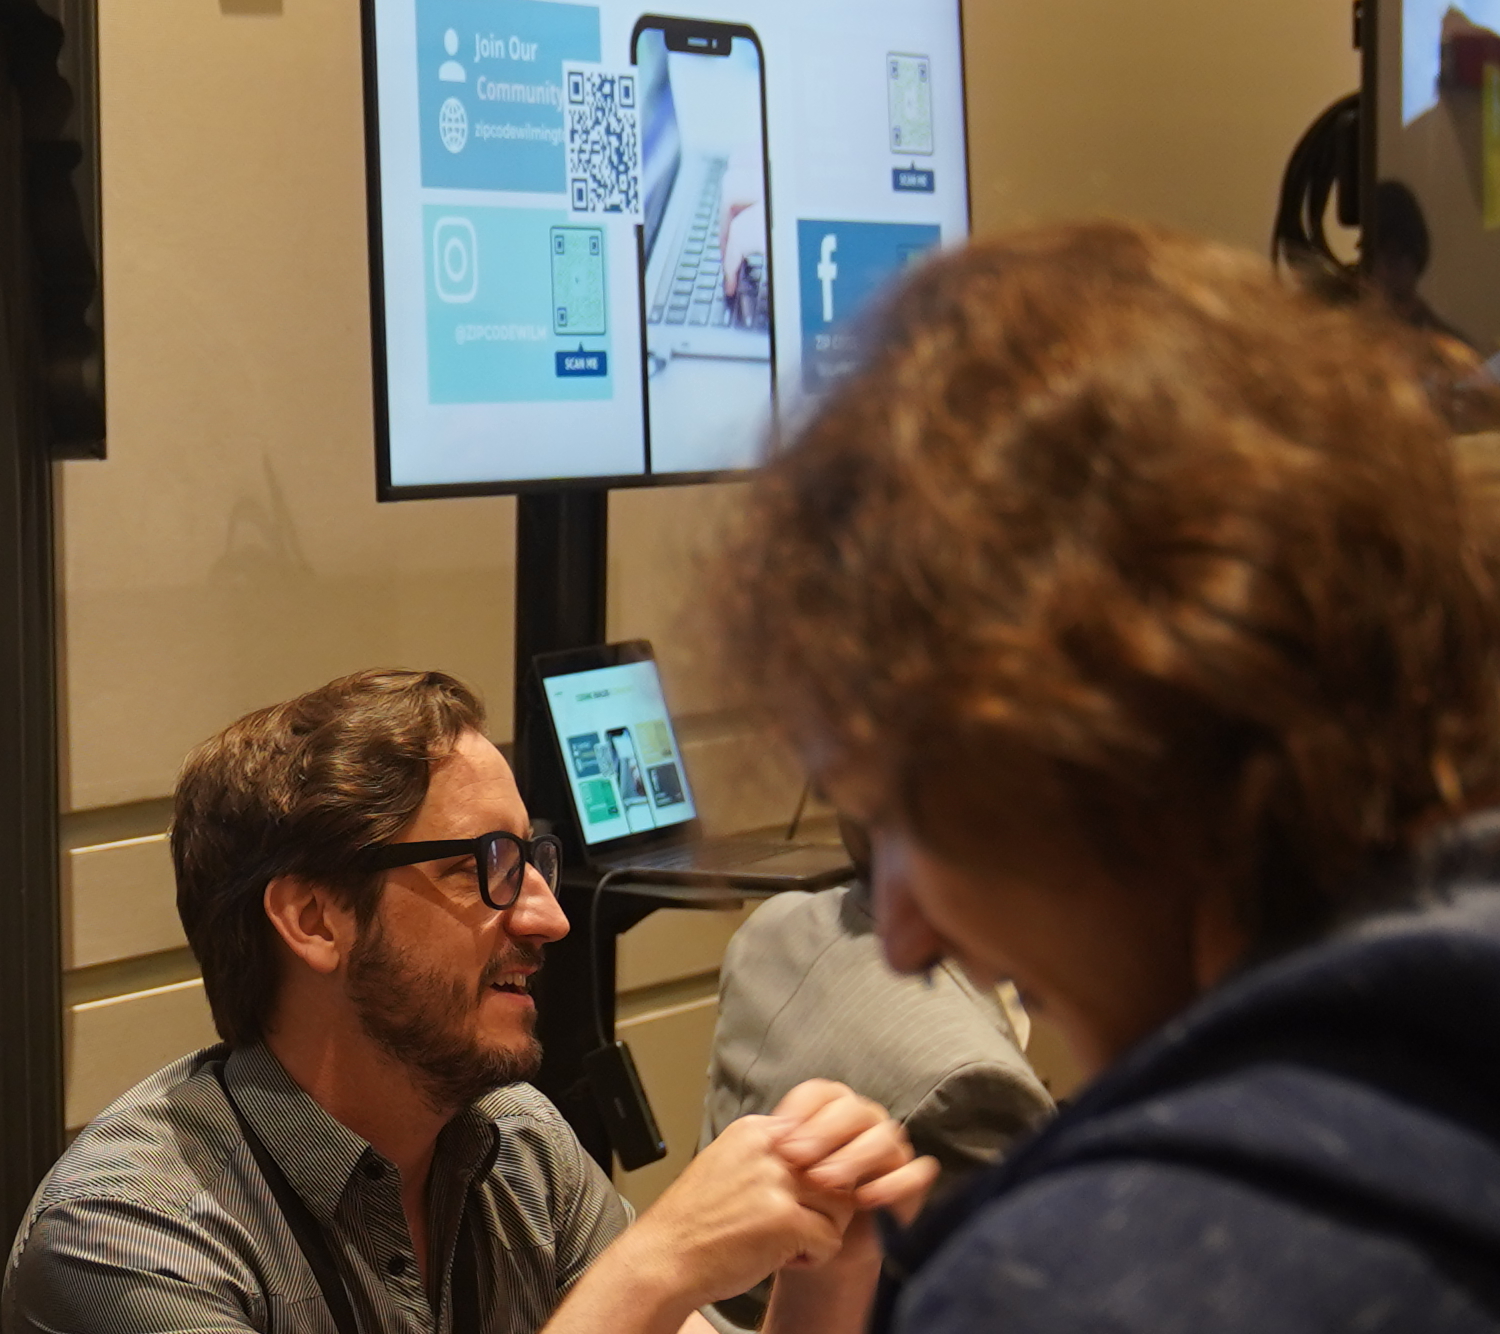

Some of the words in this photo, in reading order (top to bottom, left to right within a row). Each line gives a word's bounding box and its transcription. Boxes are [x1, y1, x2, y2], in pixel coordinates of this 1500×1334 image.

[473, 32, 505, 63] Join
[508, 34, 539, 61] Our
[476, 74, 564, 113] Community
